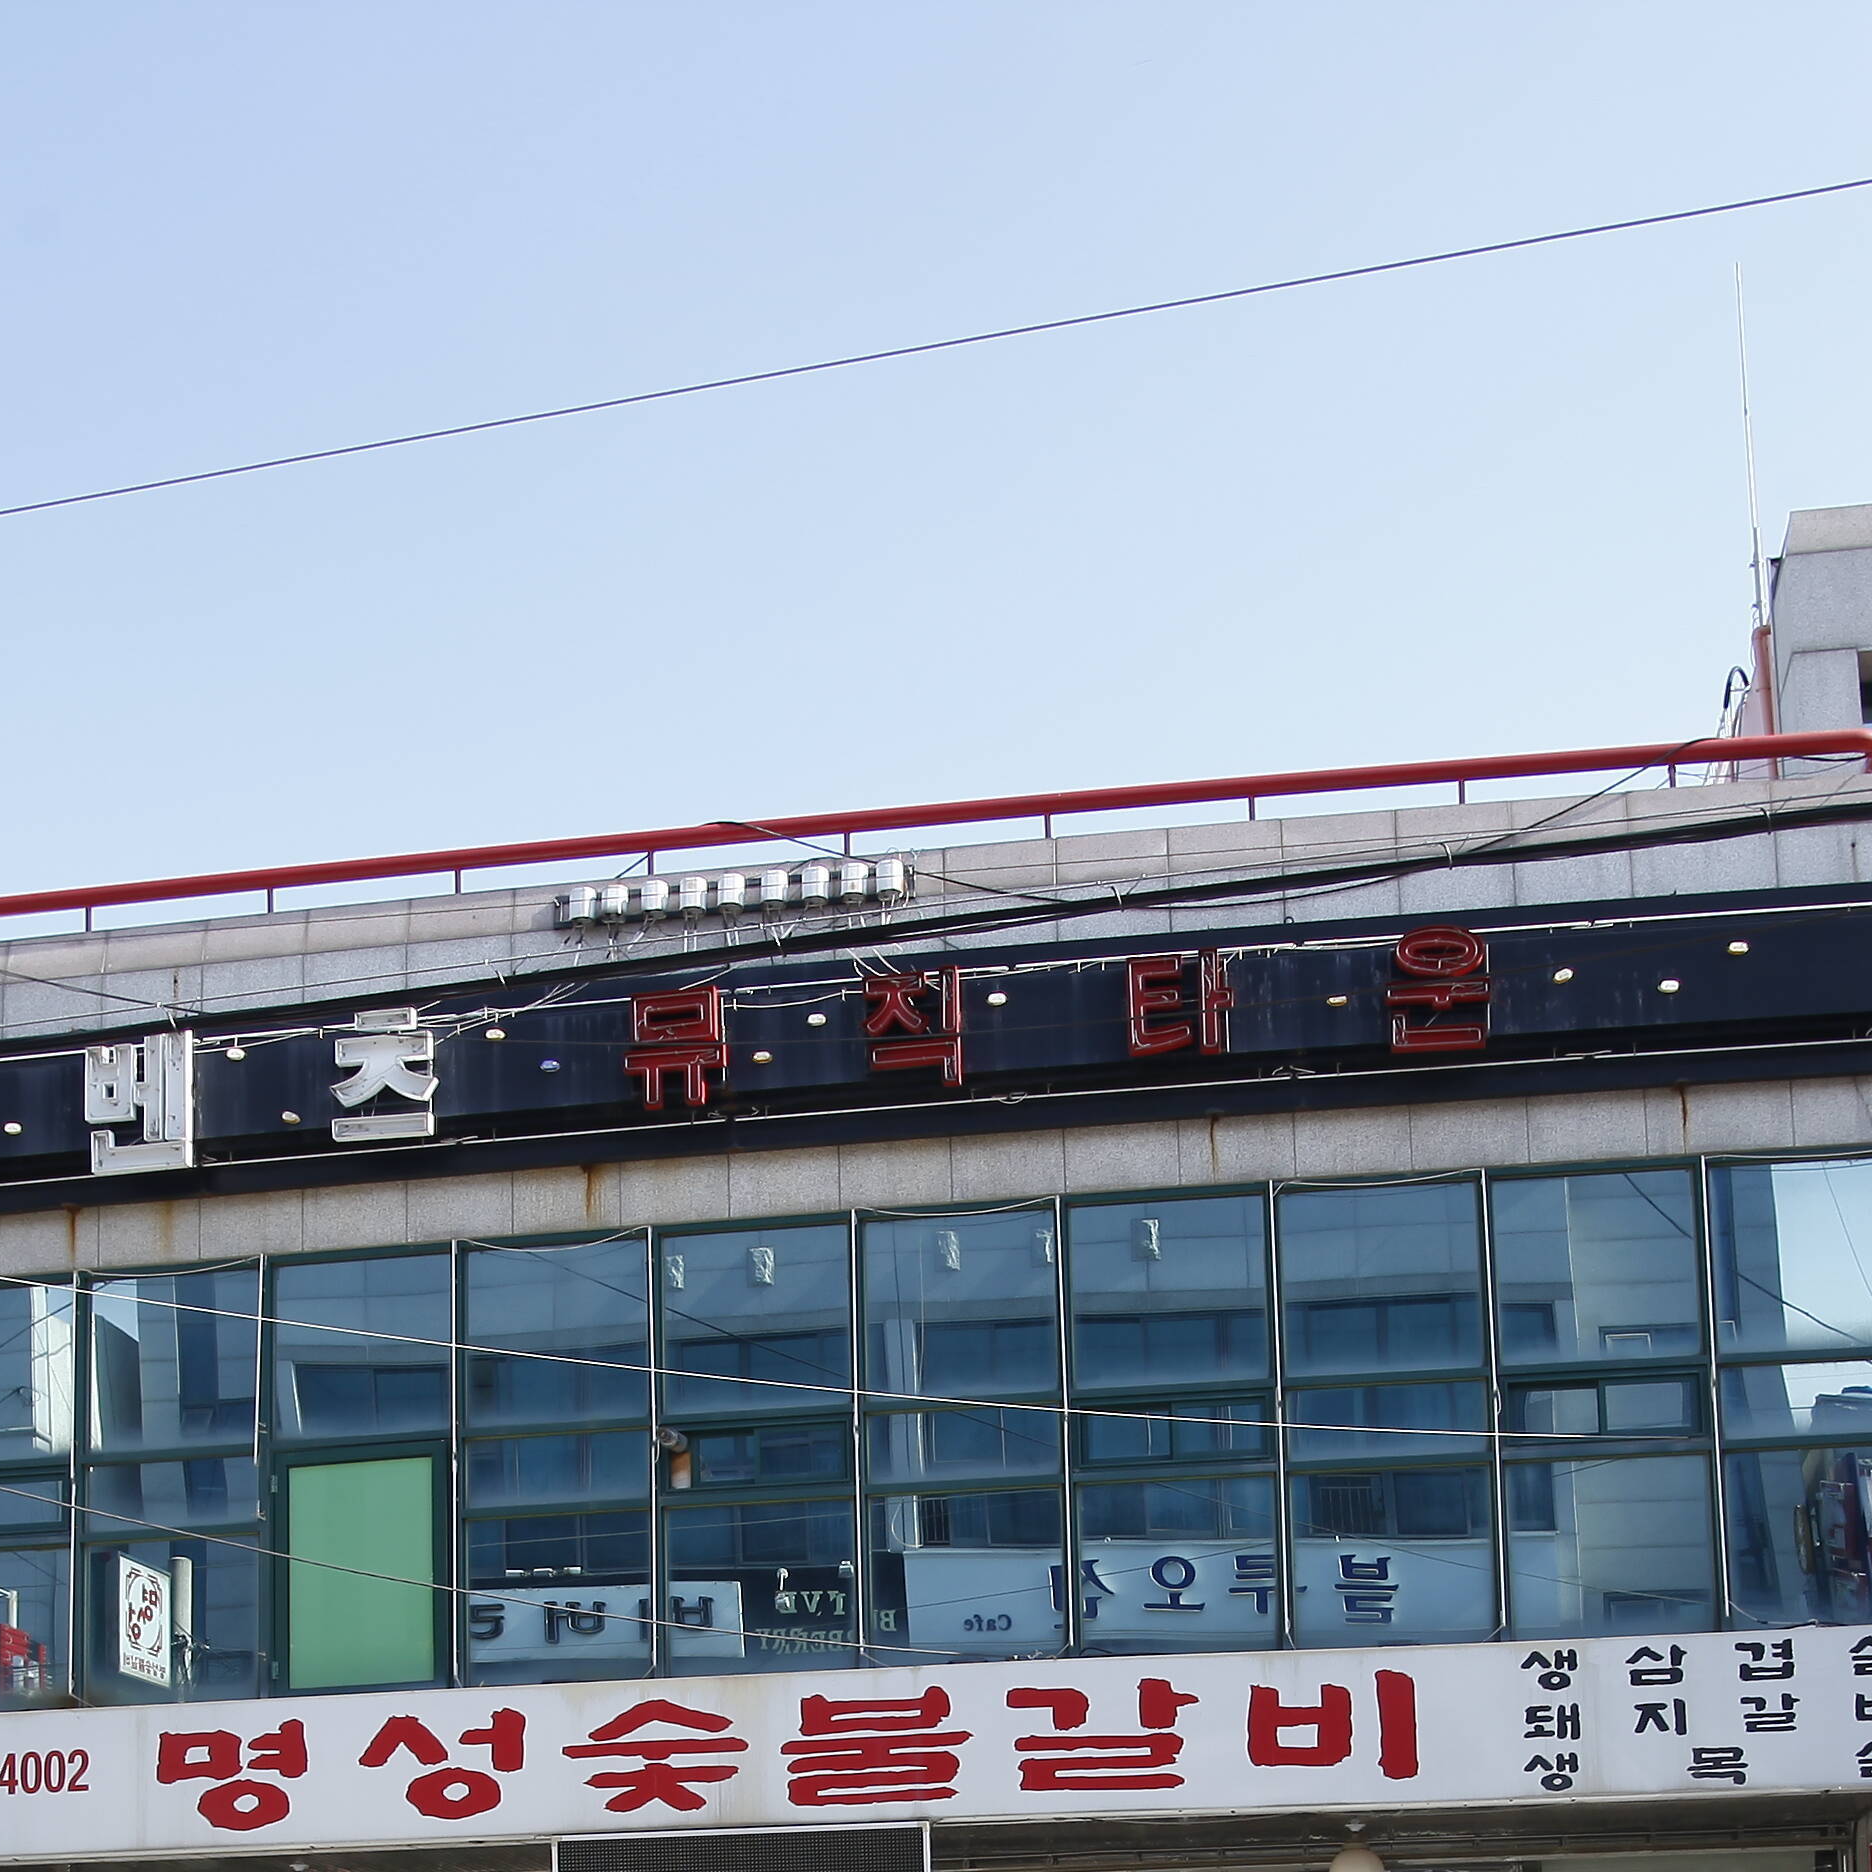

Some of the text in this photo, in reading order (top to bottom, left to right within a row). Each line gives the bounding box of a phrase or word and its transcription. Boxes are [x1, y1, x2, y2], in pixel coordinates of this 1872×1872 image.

[85, 925, 1490, 1175] 벤츠 뮤직타운
[155, 1669, 1419, 1832] 명성숯불갈비
